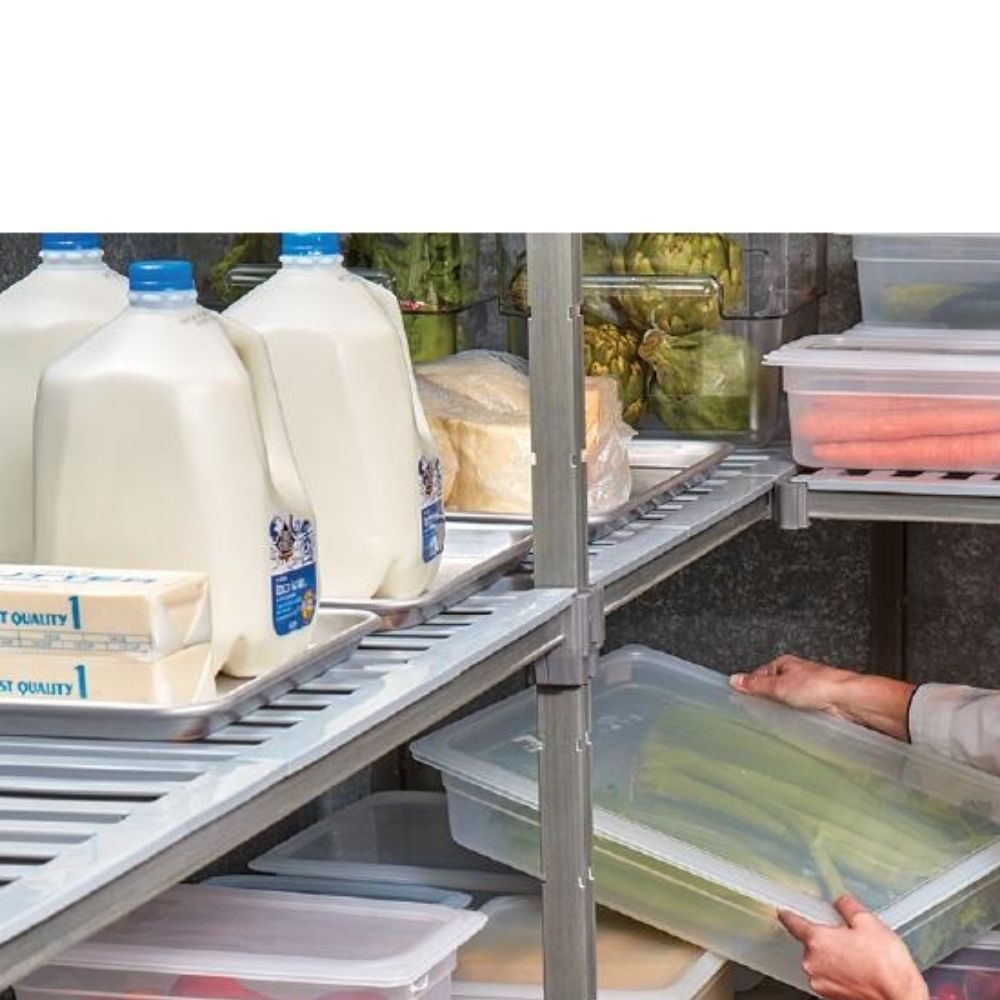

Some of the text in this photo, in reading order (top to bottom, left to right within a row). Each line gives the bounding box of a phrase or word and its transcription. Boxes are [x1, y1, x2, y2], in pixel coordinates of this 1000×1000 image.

[10, 611, 68, 626] QUALITY
[68, 595, 81, 630] 1
[17, 681, 73, 696] QUALITY
[73, 664, 87, 699] 1
